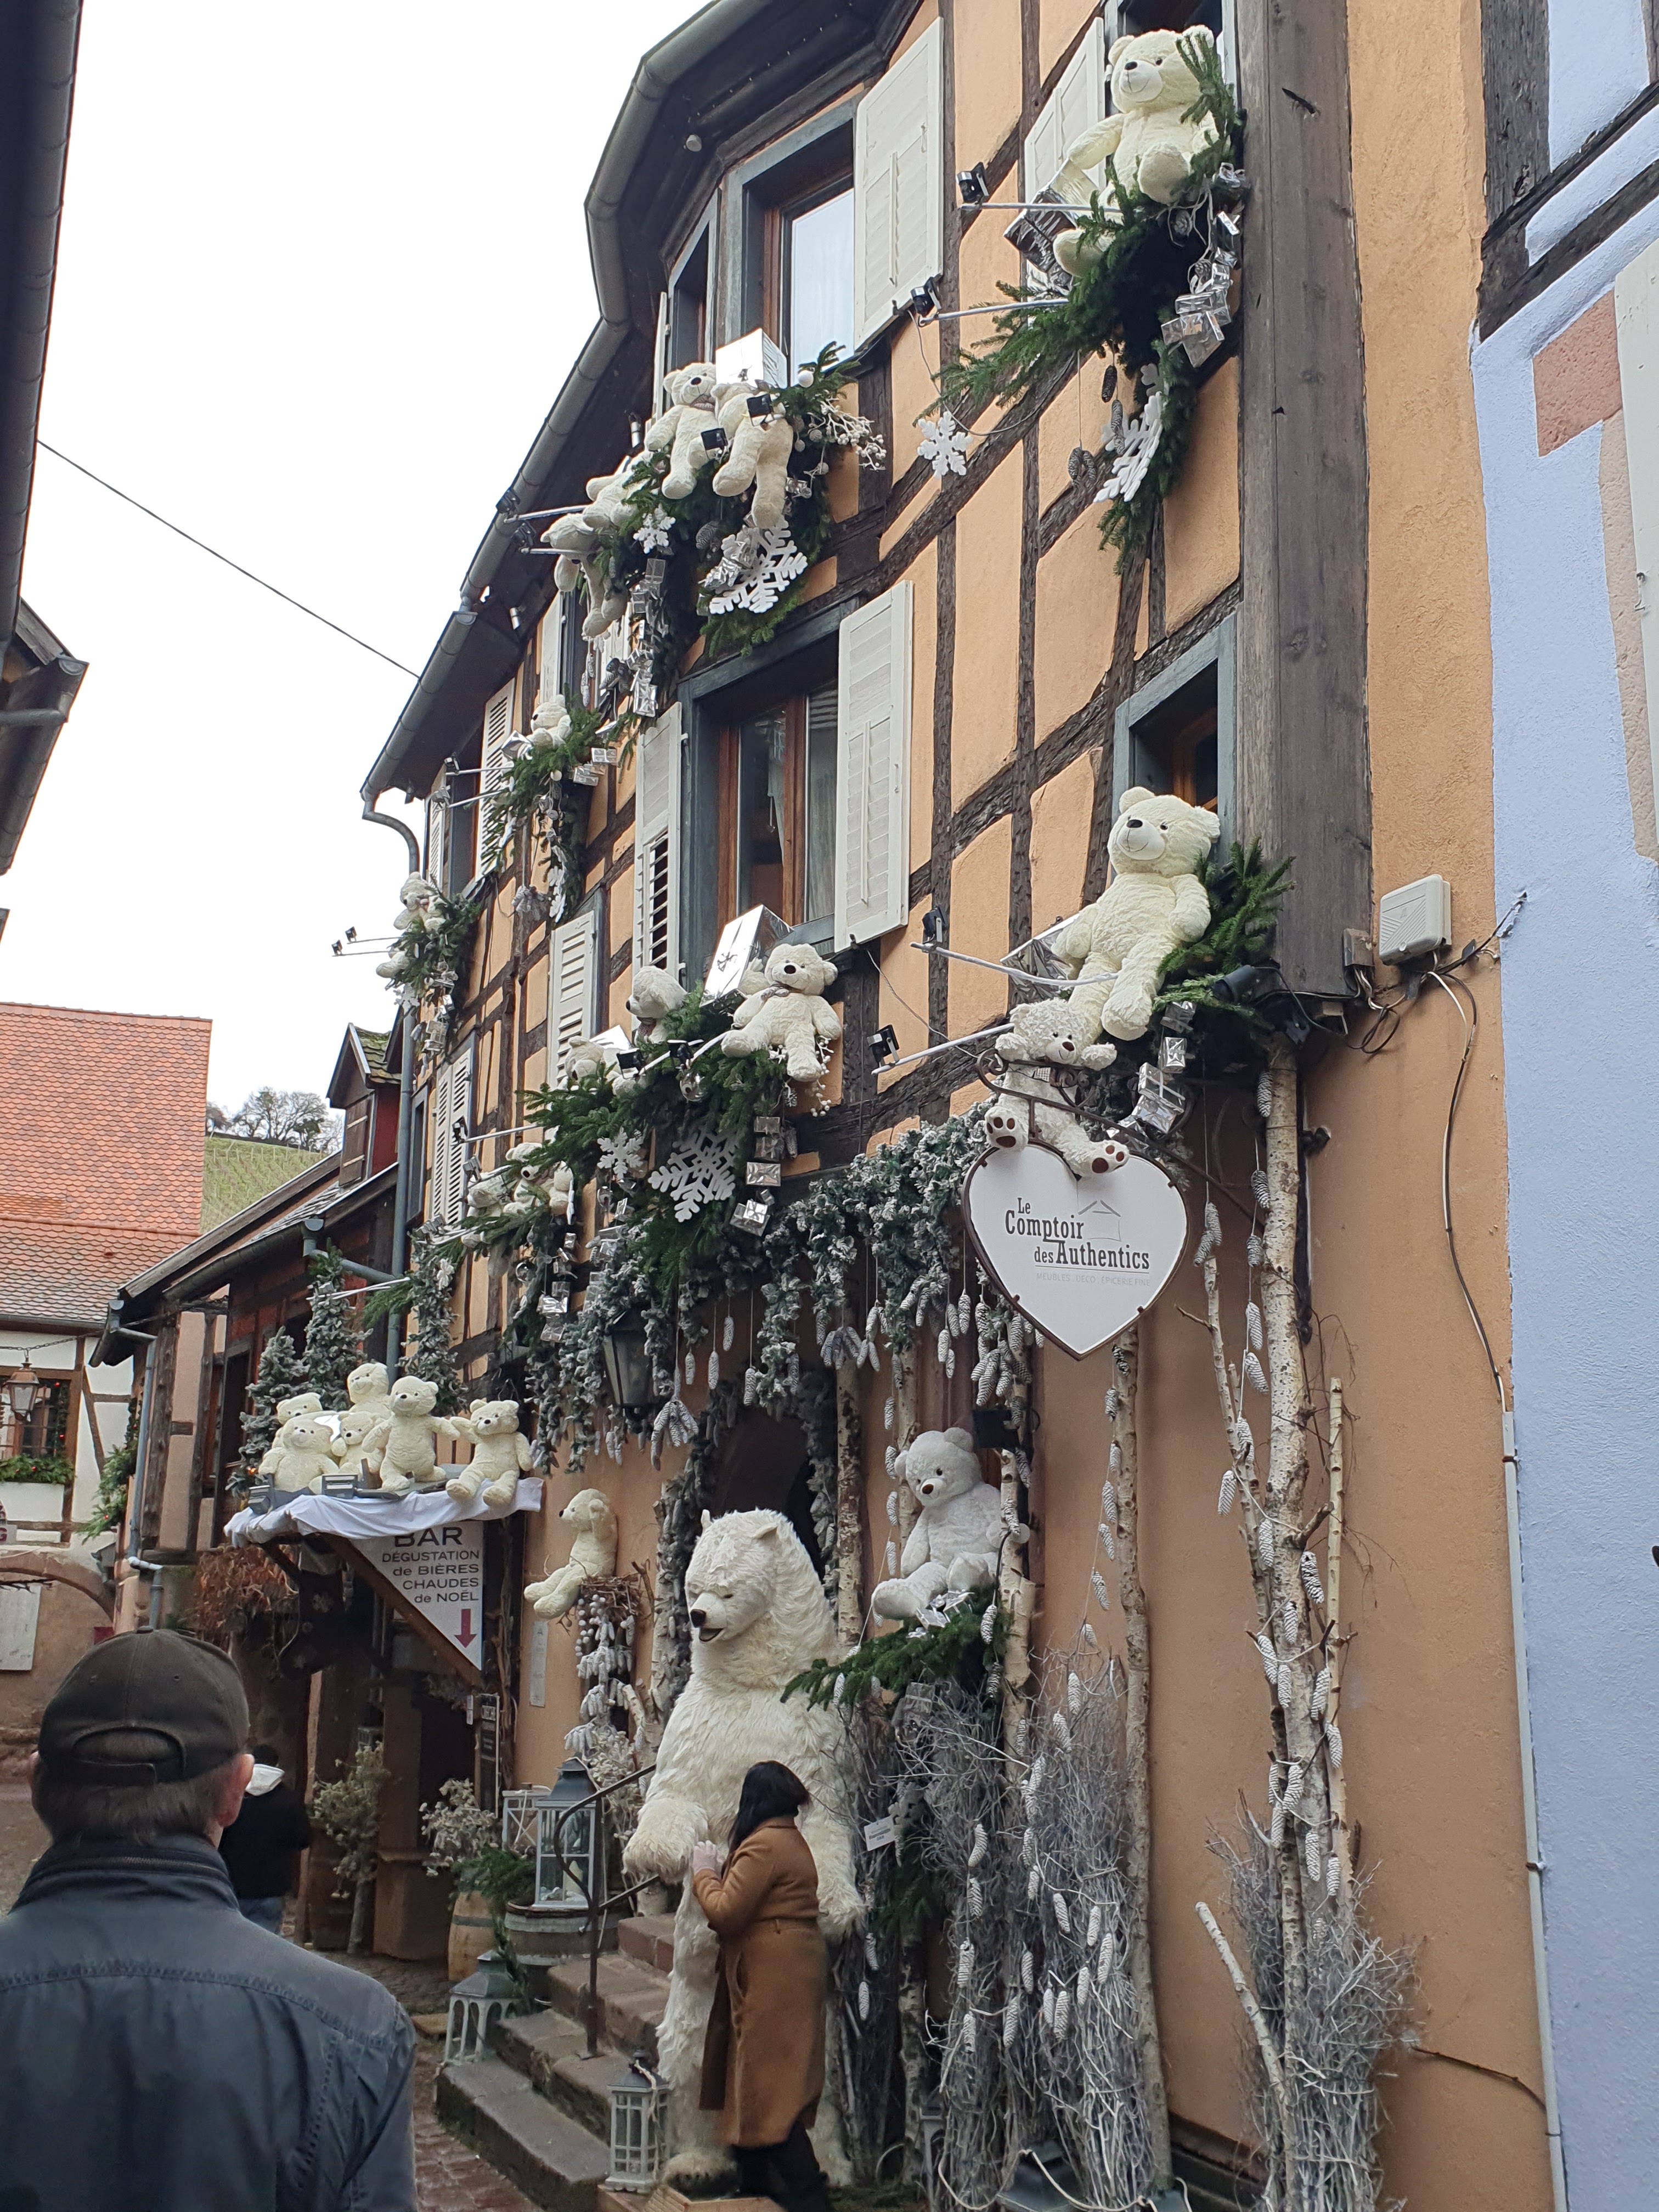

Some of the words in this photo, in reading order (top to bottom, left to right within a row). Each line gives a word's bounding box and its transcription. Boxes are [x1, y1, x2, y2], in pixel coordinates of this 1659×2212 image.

[1017, 1197, 1031, 1215] Le
[1005, 1209, 1084, 1242] Comptoir
[1034, 1246, 1054, 1263] des
[1055, 1240, 1150, 1269] Authentics
[1036, 1272, 1070, 1282] MEUBLES
[1135, 1278, 1150, 1286] FINE
[382, 1550, 479, 1562] DÉGUSTATION
[393, 1567, 412, 1576] de
[418, 1563, 479, 1575] BIÈRES
[403, 1577, 479, 1590] CHAUDES
[414, 1594, 432, 1603] de
